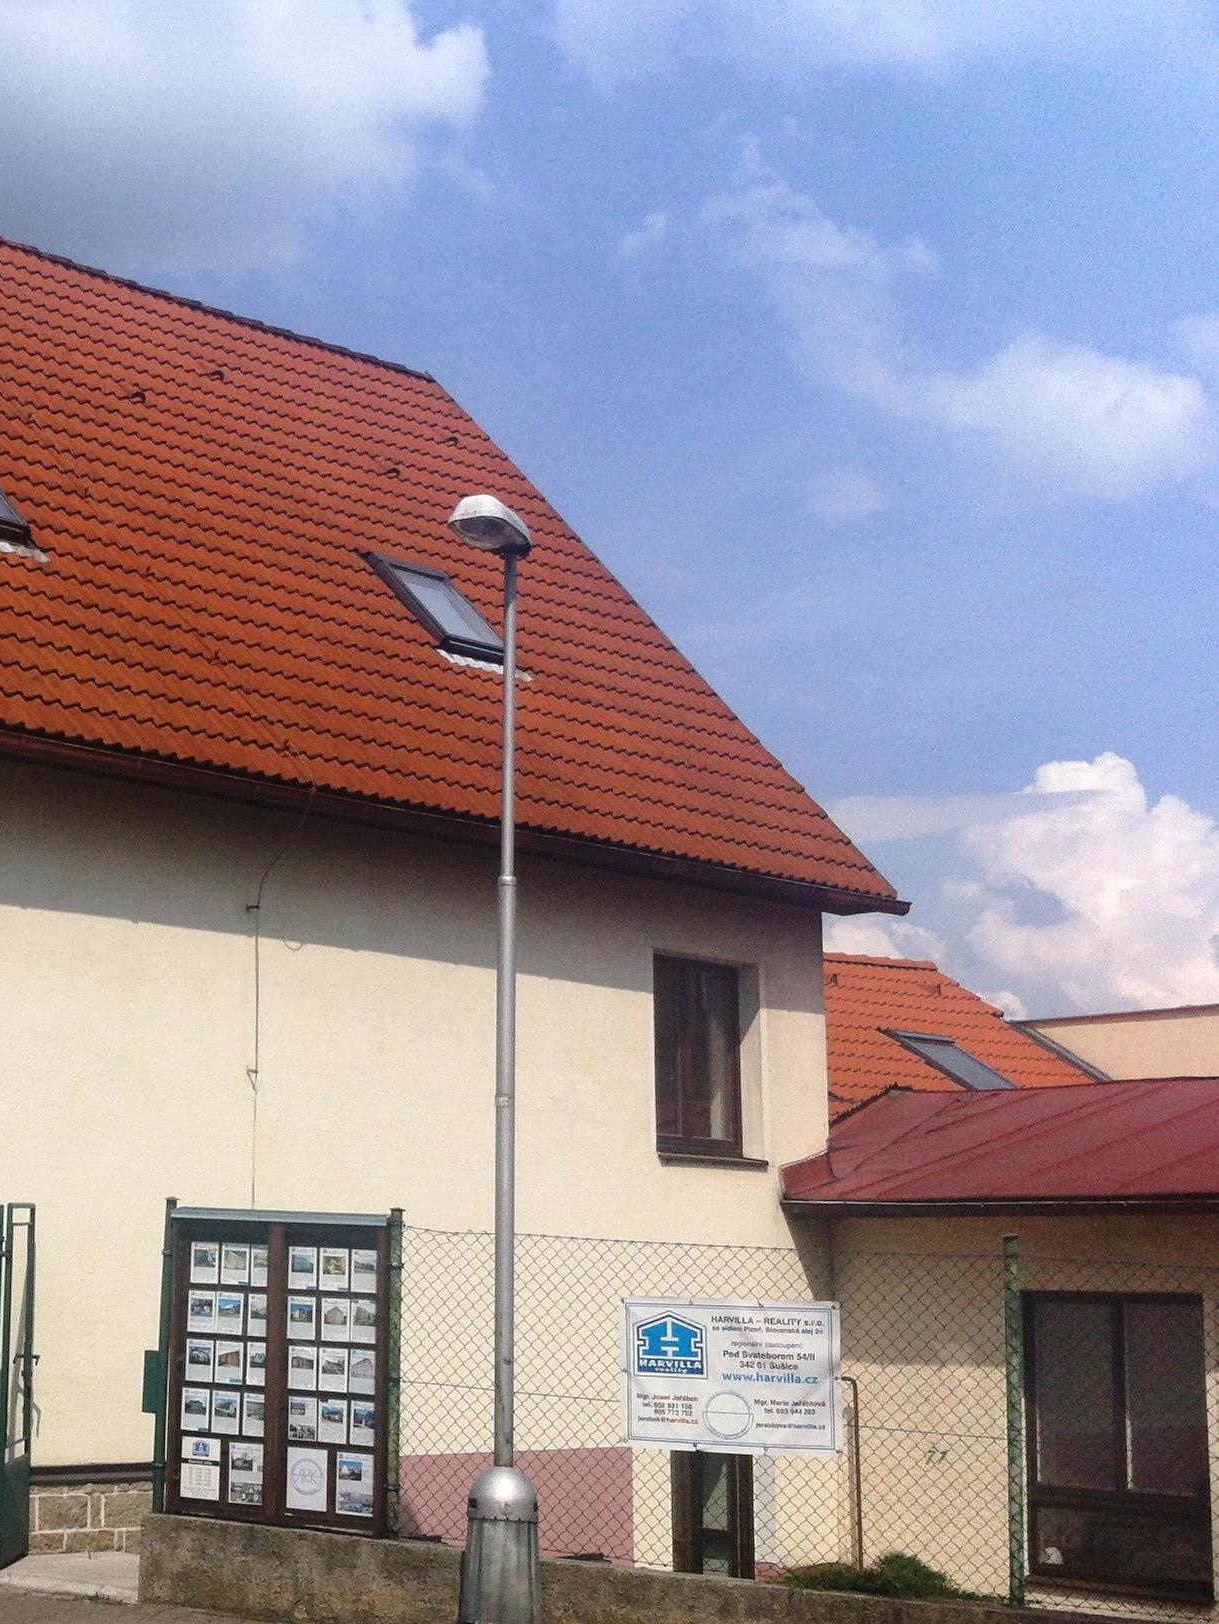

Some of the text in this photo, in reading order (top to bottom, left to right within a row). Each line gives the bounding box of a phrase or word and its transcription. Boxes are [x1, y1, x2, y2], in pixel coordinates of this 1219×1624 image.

[711, 1315, 754, 1325] HARVILLA
[763, 1317, 801, 1326] REALITY
[722, 1350, 740, 1358] Pod
[639, 1359, 702, 1369] HARVILLA
[739, 1361, 755, 1369] 342
[722, 1371, 818, 1384] www.harvilla.cz
